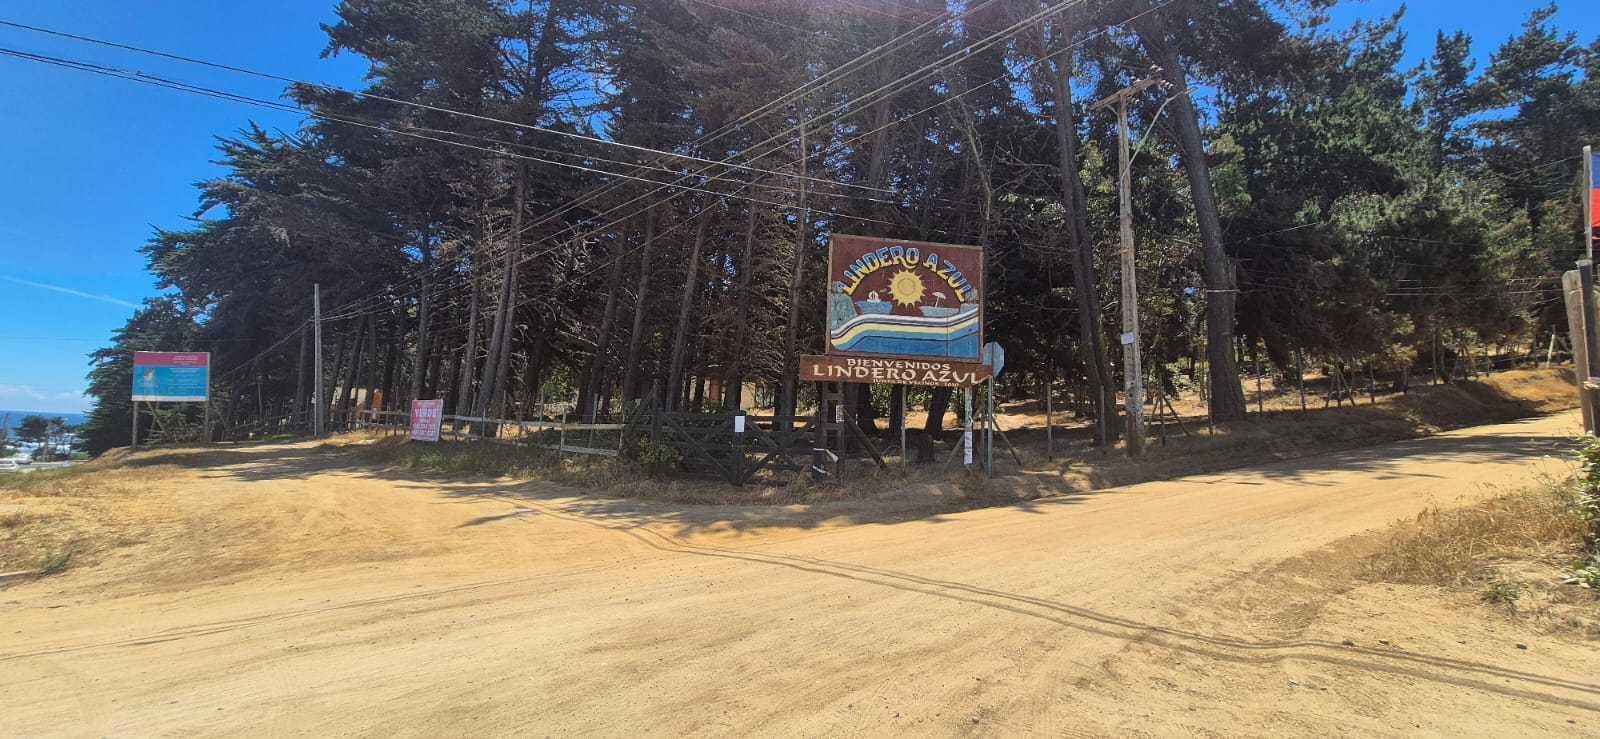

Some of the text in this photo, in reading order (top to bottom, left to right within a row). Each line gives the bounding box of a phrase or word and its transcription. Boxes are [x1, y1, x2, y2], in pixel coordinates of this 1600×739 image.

[837, 245, 972, 303] LINDERO AZUL
[812, 364, 993, 385] LINDERO AZUL
[846, 358, 951, 371] BIENVENIDOS
